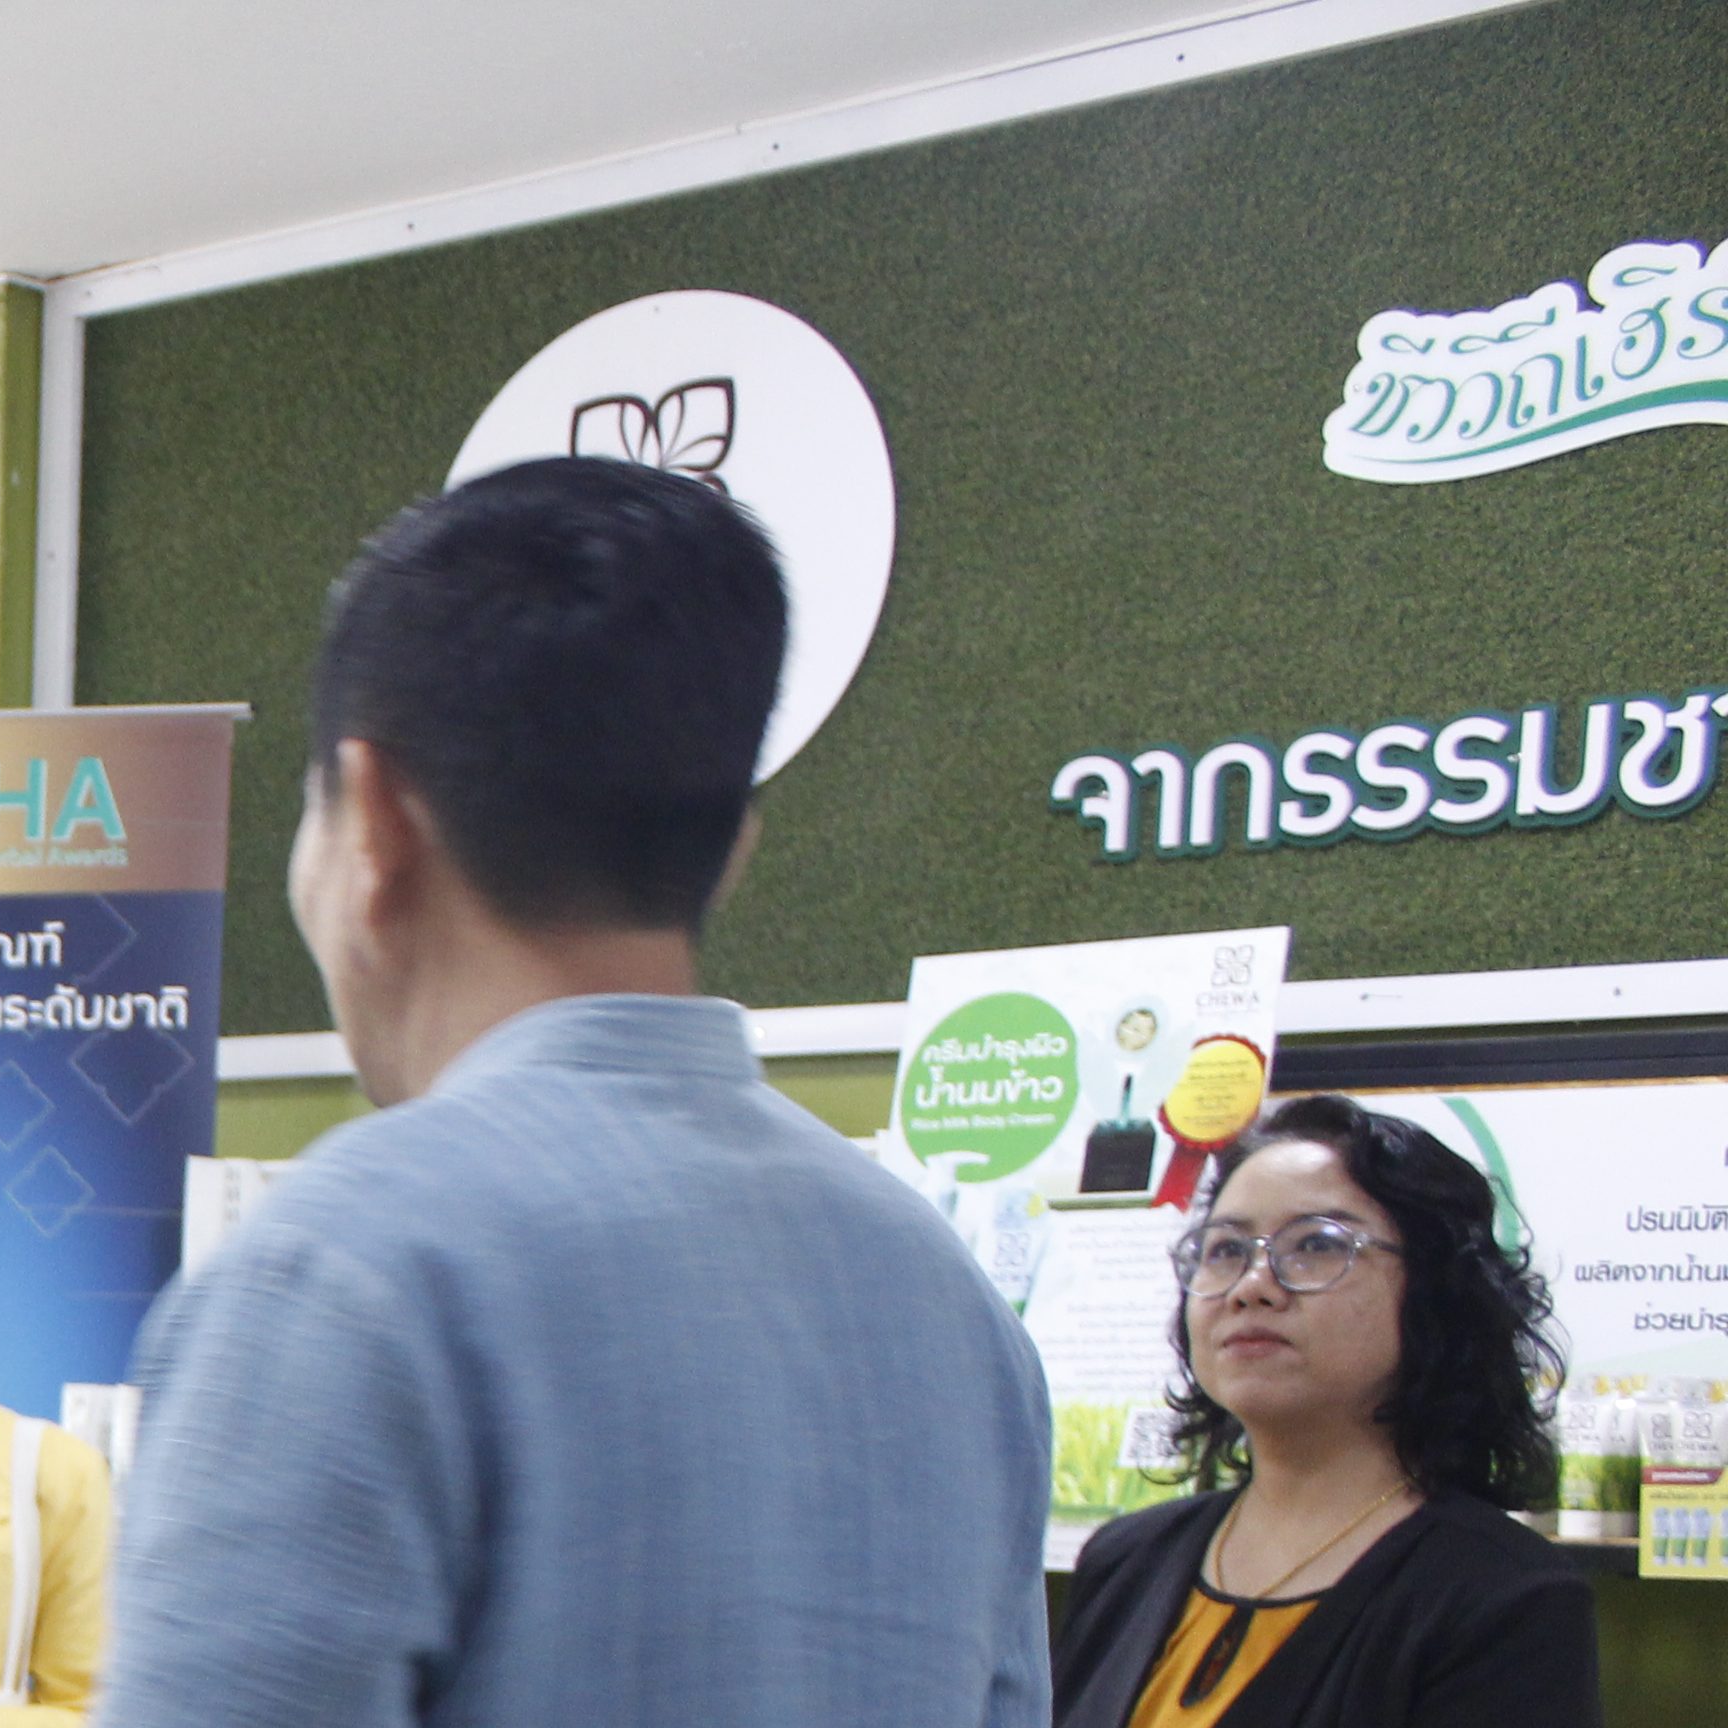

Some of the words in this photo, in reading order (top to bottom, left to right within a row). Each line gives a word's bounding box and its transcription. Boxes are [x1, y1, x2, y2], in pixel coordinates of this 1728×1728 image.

[47, 845, 128, 867] Awards
[1195, 991, 1260, 1007] CHEWA
[921, 1032, 1069, 1066] ครีมบำรุงผิว
[915, 1065, 1065, 1109] น้ำนมข้าว
